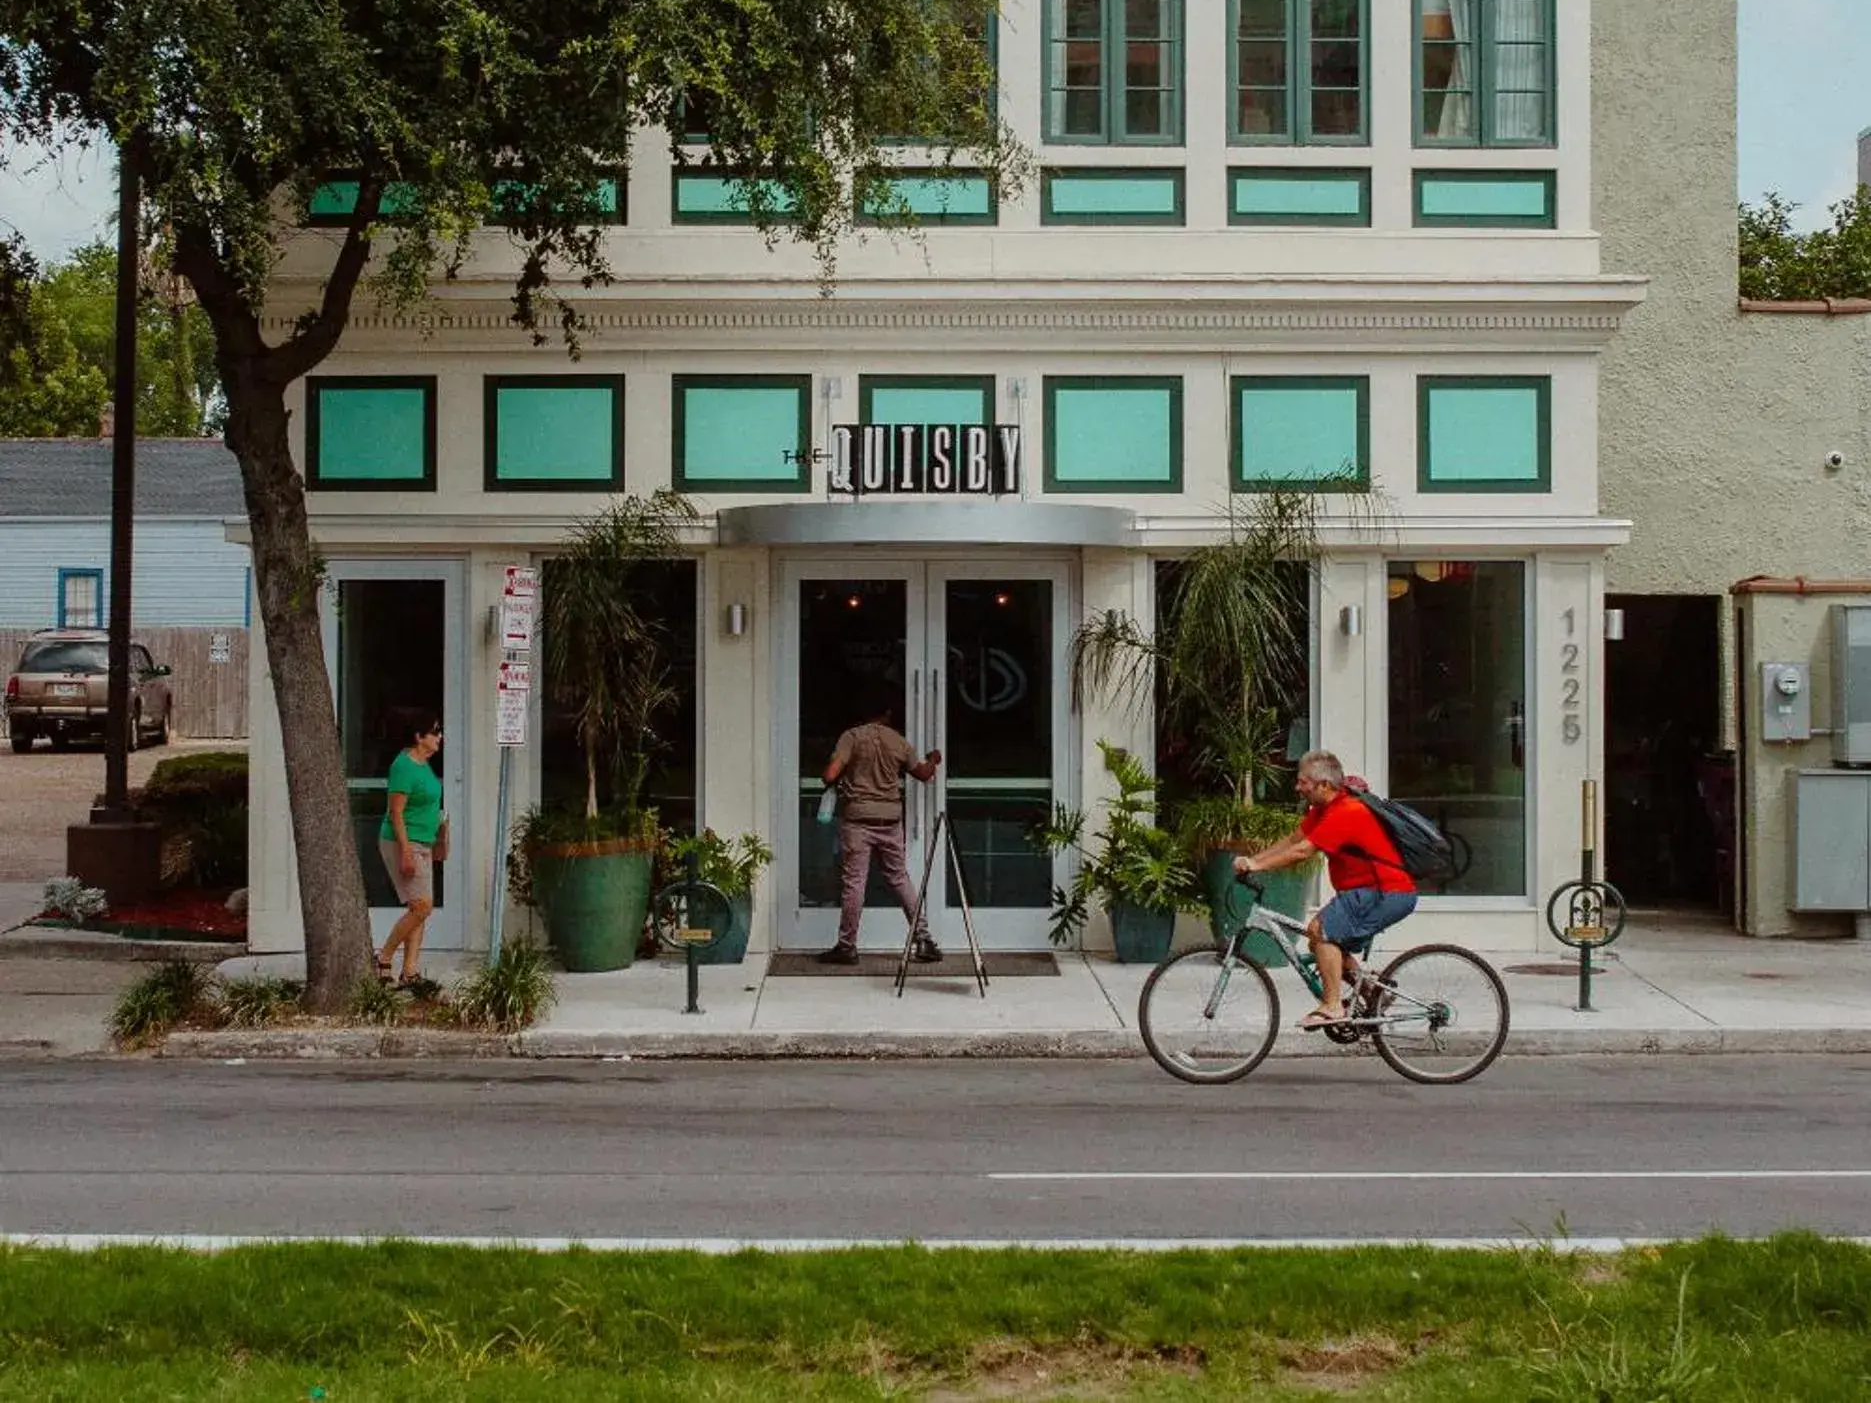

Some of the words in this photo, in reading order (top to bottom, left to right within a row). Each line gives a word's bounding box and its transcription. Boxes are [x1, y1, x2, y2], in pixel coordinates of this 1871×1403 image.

[782, 448, 822, 465] THE
[832, 427, 1019, 491] QUISBY
[1559, 606, 1581, 745] 1225
